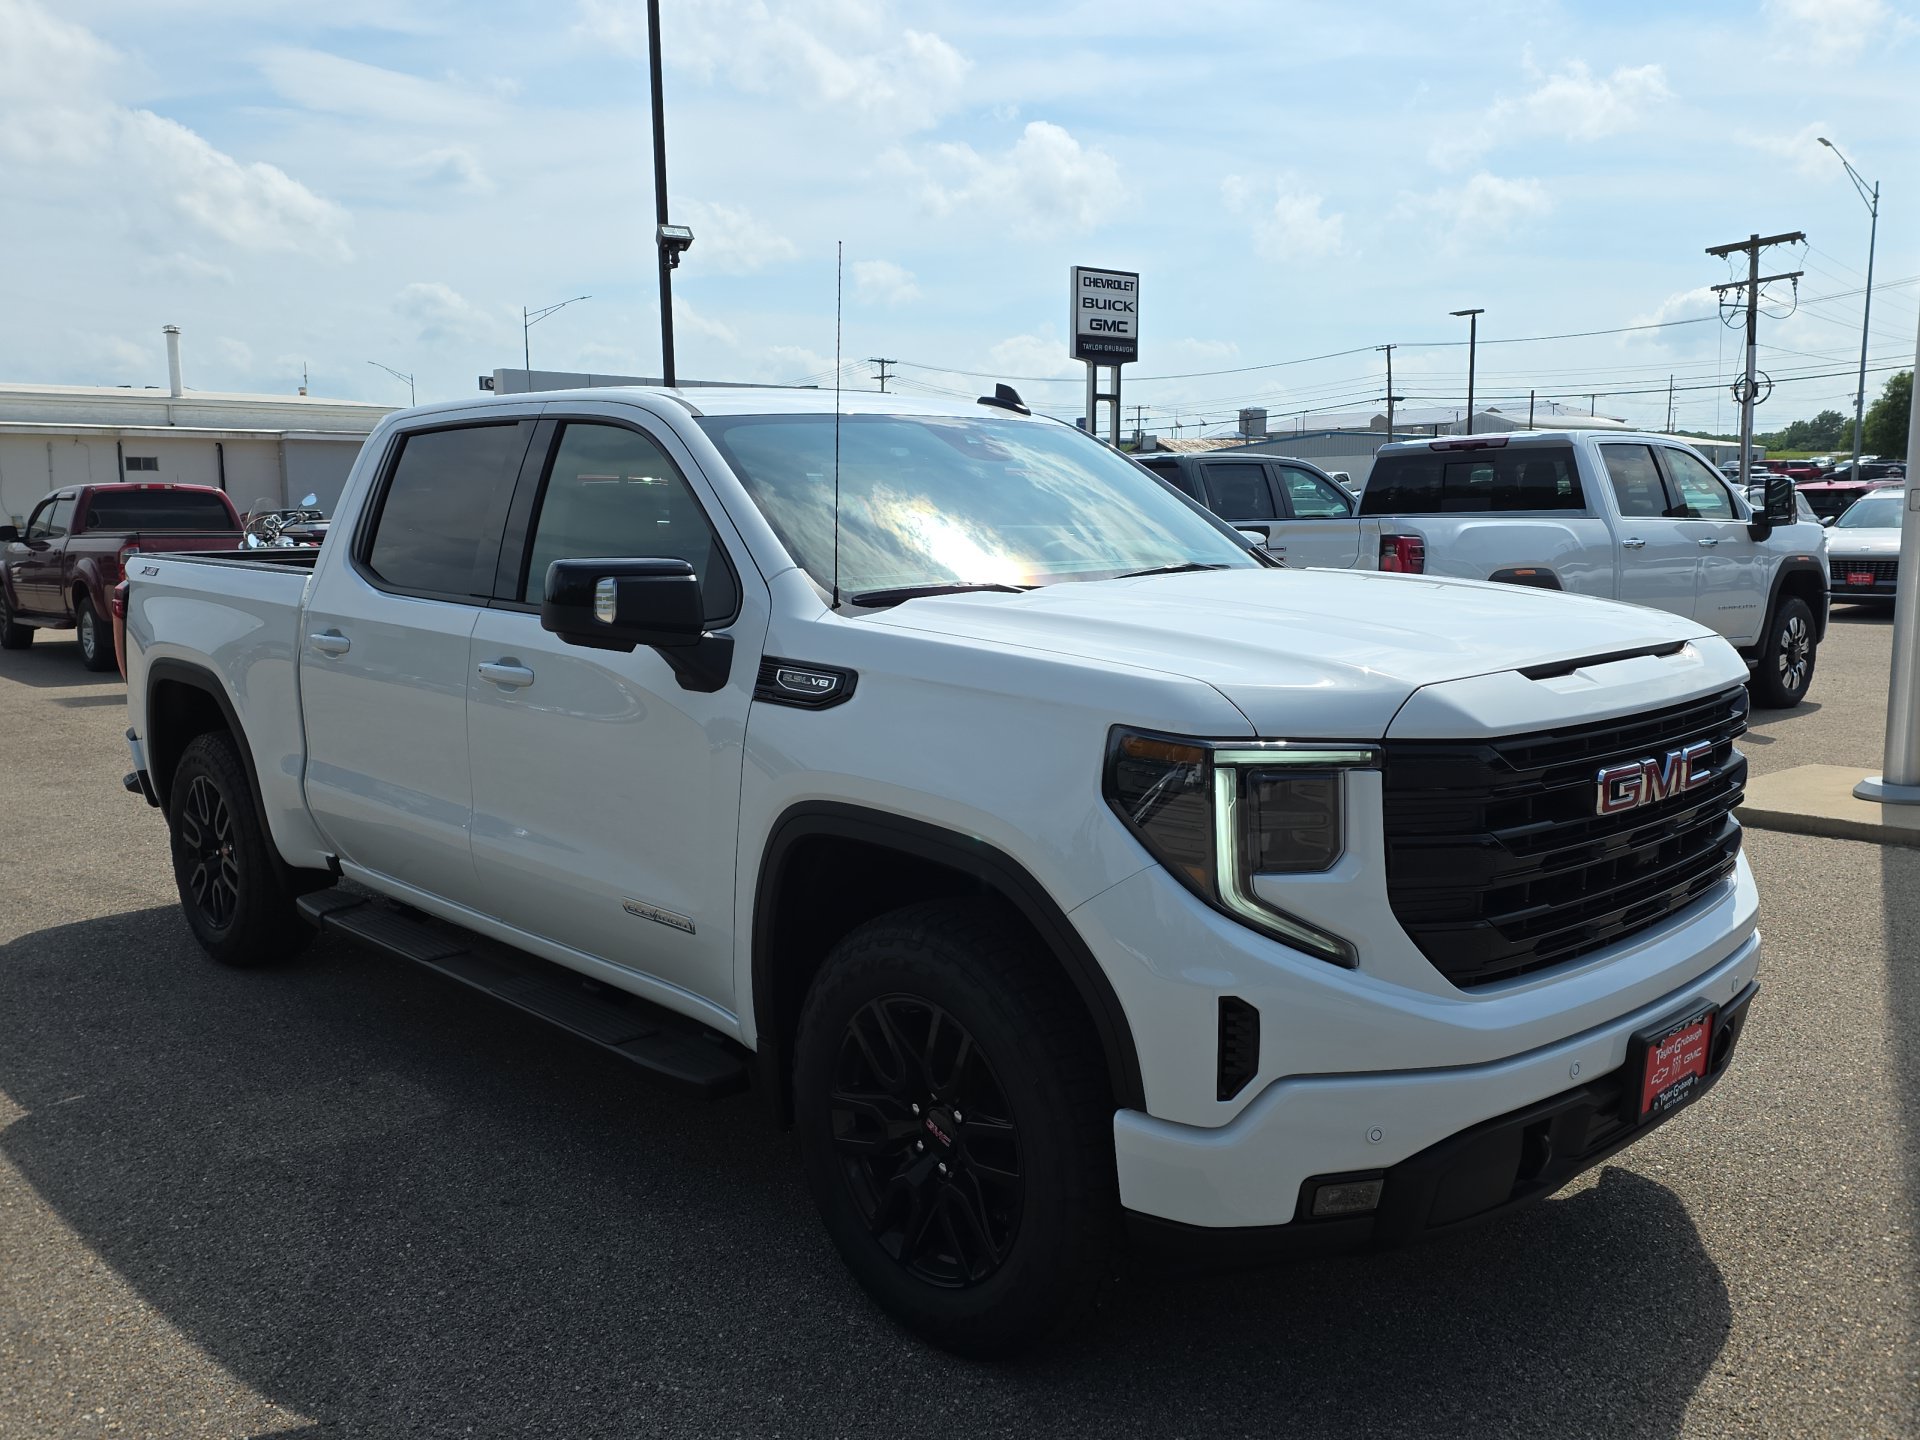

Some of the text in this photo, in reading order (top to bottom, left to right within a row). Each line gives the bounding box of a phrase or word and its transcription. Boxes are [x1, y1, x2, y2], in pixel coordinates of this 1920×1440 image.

[1083, 276, 1135, 292] CHEVROLET
[1082, 296, 1135, 313] BUICK
[1089, 318, 1128, 333] GMC
[1082, 343, 1103, 351] TAYLOR
[811, 677, 829, 688] V8
[1596, 738, 1713, 816] GMC
[1683, 1047, 1702, 1065] GMC
